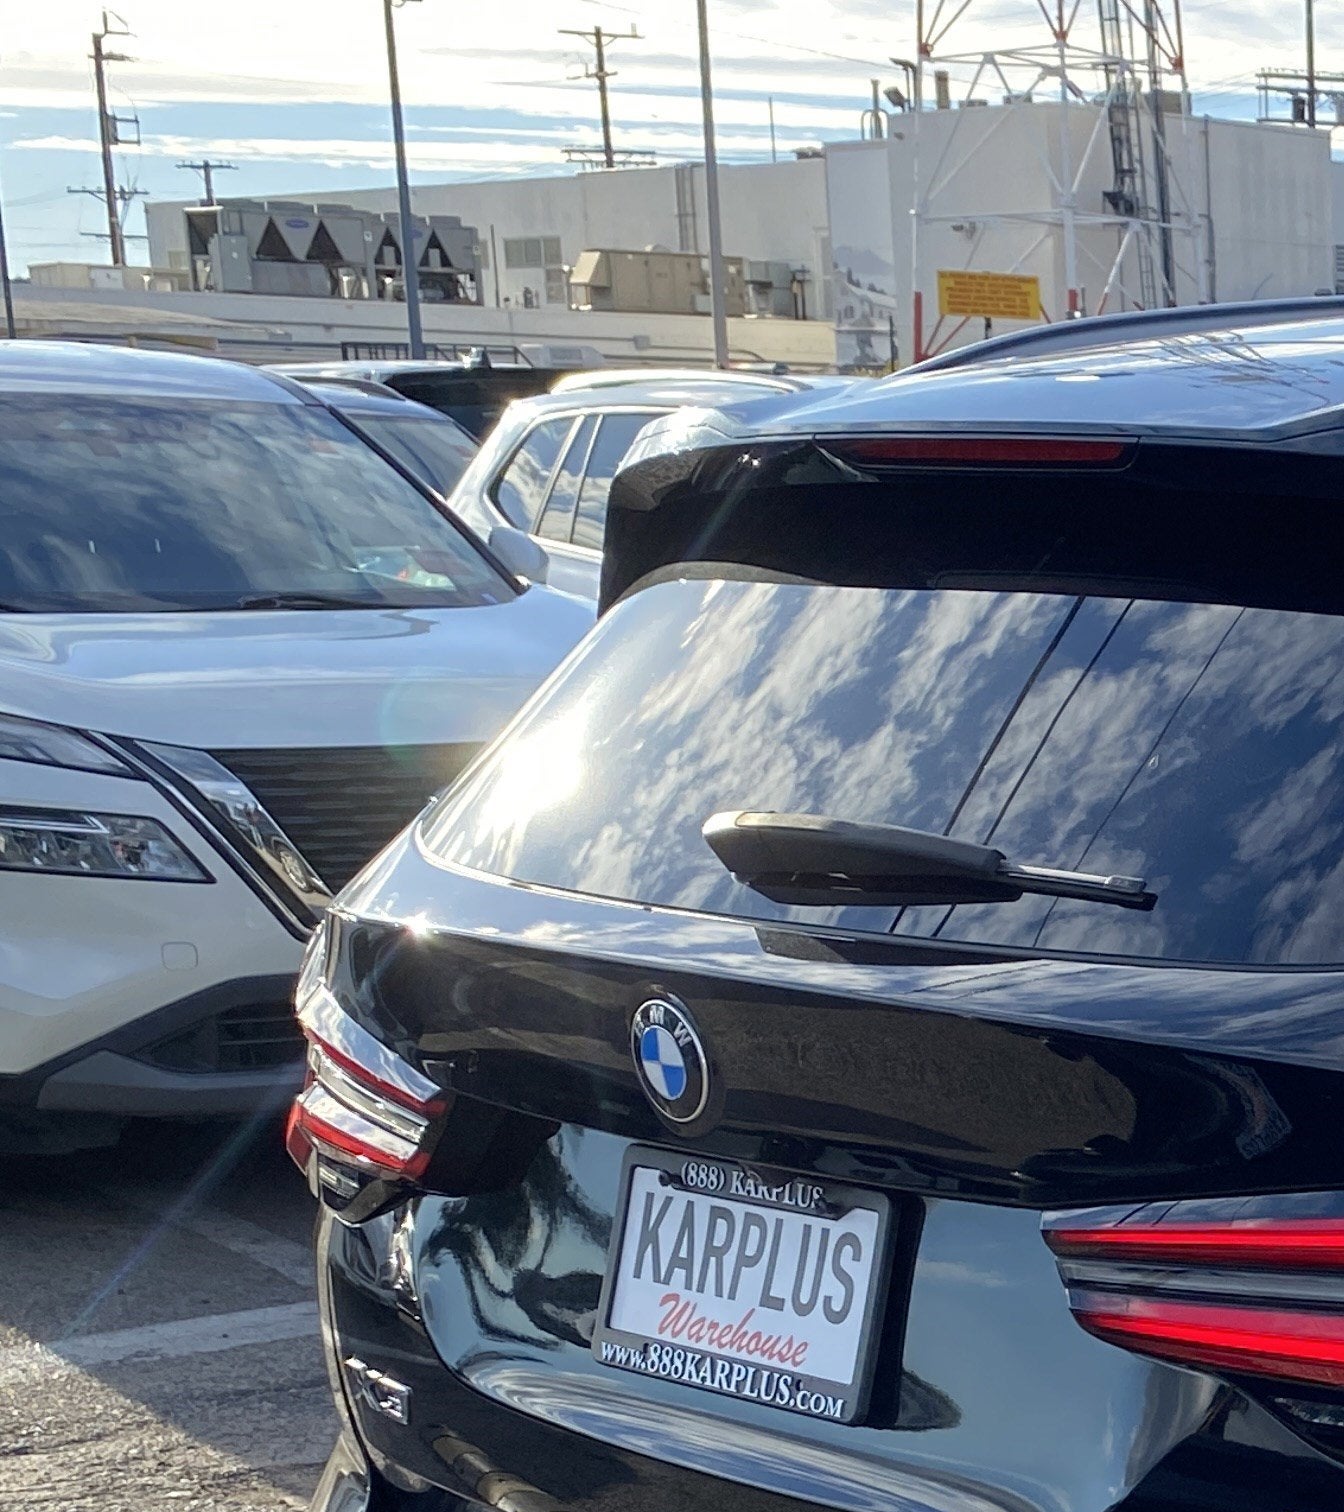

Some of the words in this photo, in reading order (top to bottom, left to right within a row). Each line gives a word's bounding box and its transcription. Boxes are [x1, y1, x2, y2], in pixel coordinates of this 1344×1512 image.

[681, 1161, 725, 1191] (888)
[632, 1191, 862, 1325] KARPLUS
[658, 1292, 809, 1368] Warehouse
